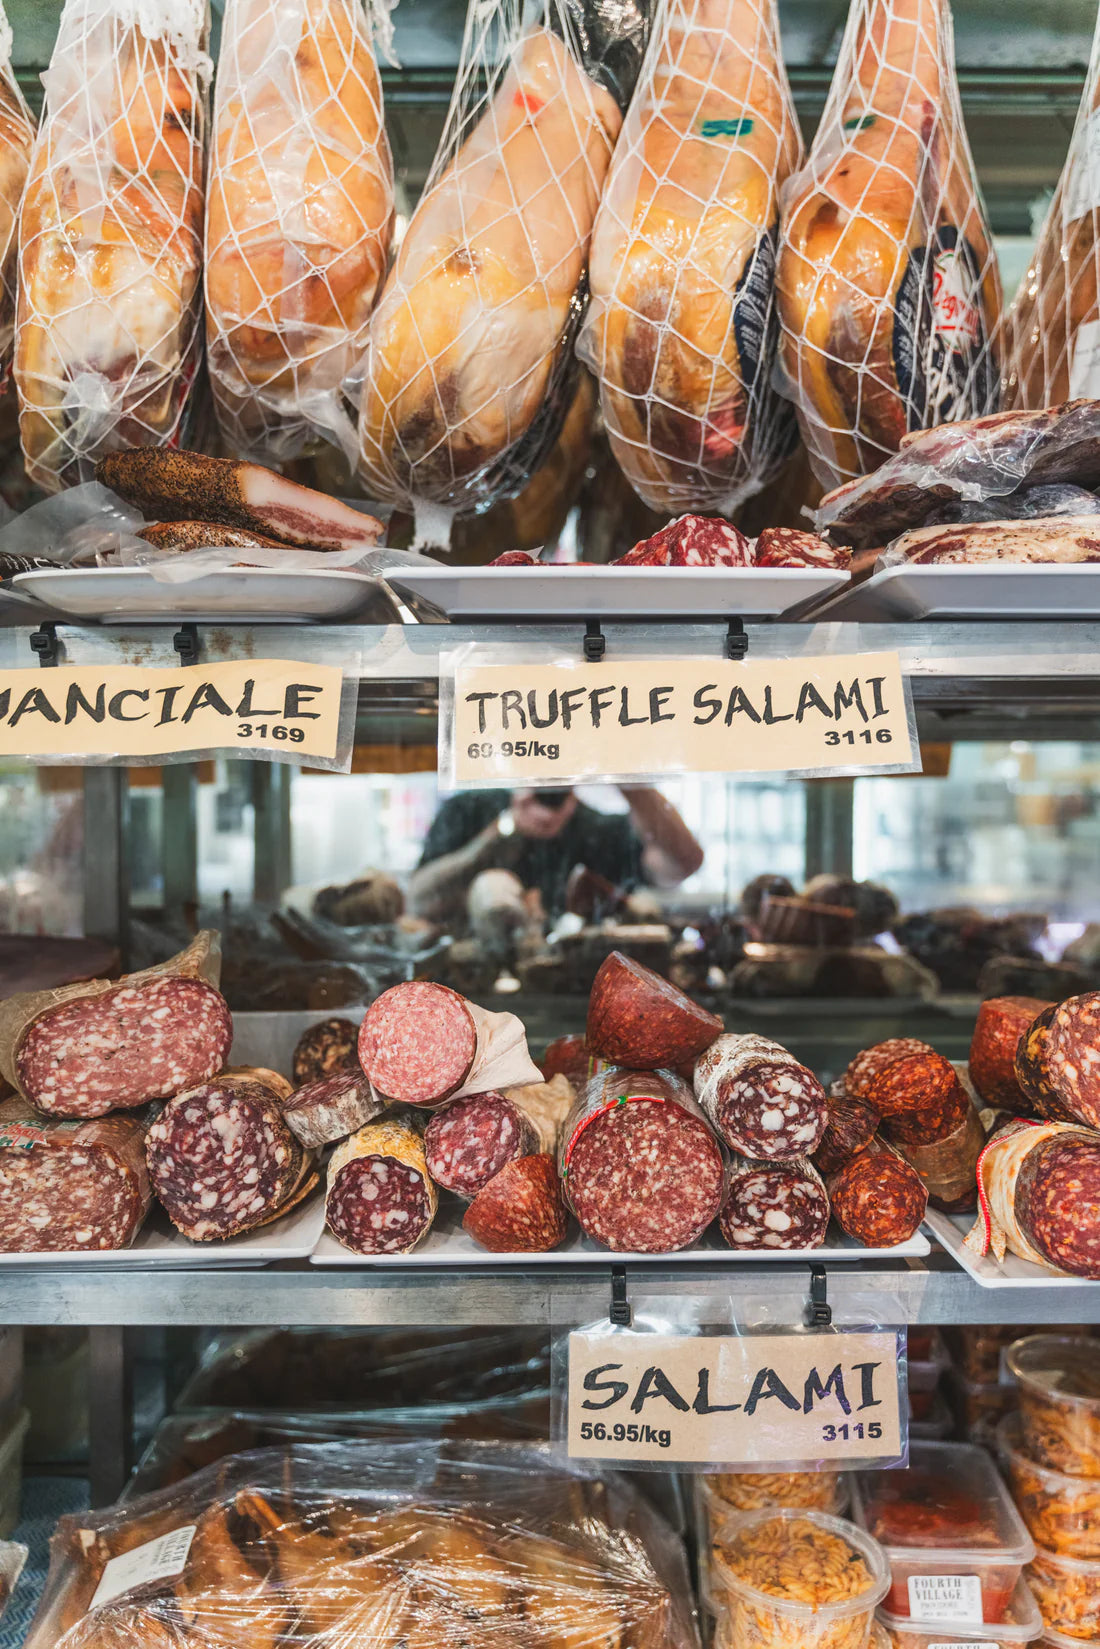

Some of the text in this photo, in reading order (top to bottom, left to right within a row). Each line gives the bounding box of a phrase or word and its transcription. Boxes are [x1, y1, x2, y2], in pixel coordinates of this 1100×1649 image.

[465, 676, 890, 733] TRUFFLE SALAMI
[236, 723, 305, 743] 3169
[824, 728, 893, 746] 3116
[467, 740, 560, 760] 6995/kg
[580, 1361, 882, 1416] SALAMI
[580, 1422, 671, 1447] 56.95/kg
[822, 1422, 882, 1441] 3115
[914, 1578, 962, 1588] FOURTH
[915, 1589, 964, 1600] VILLAGE
